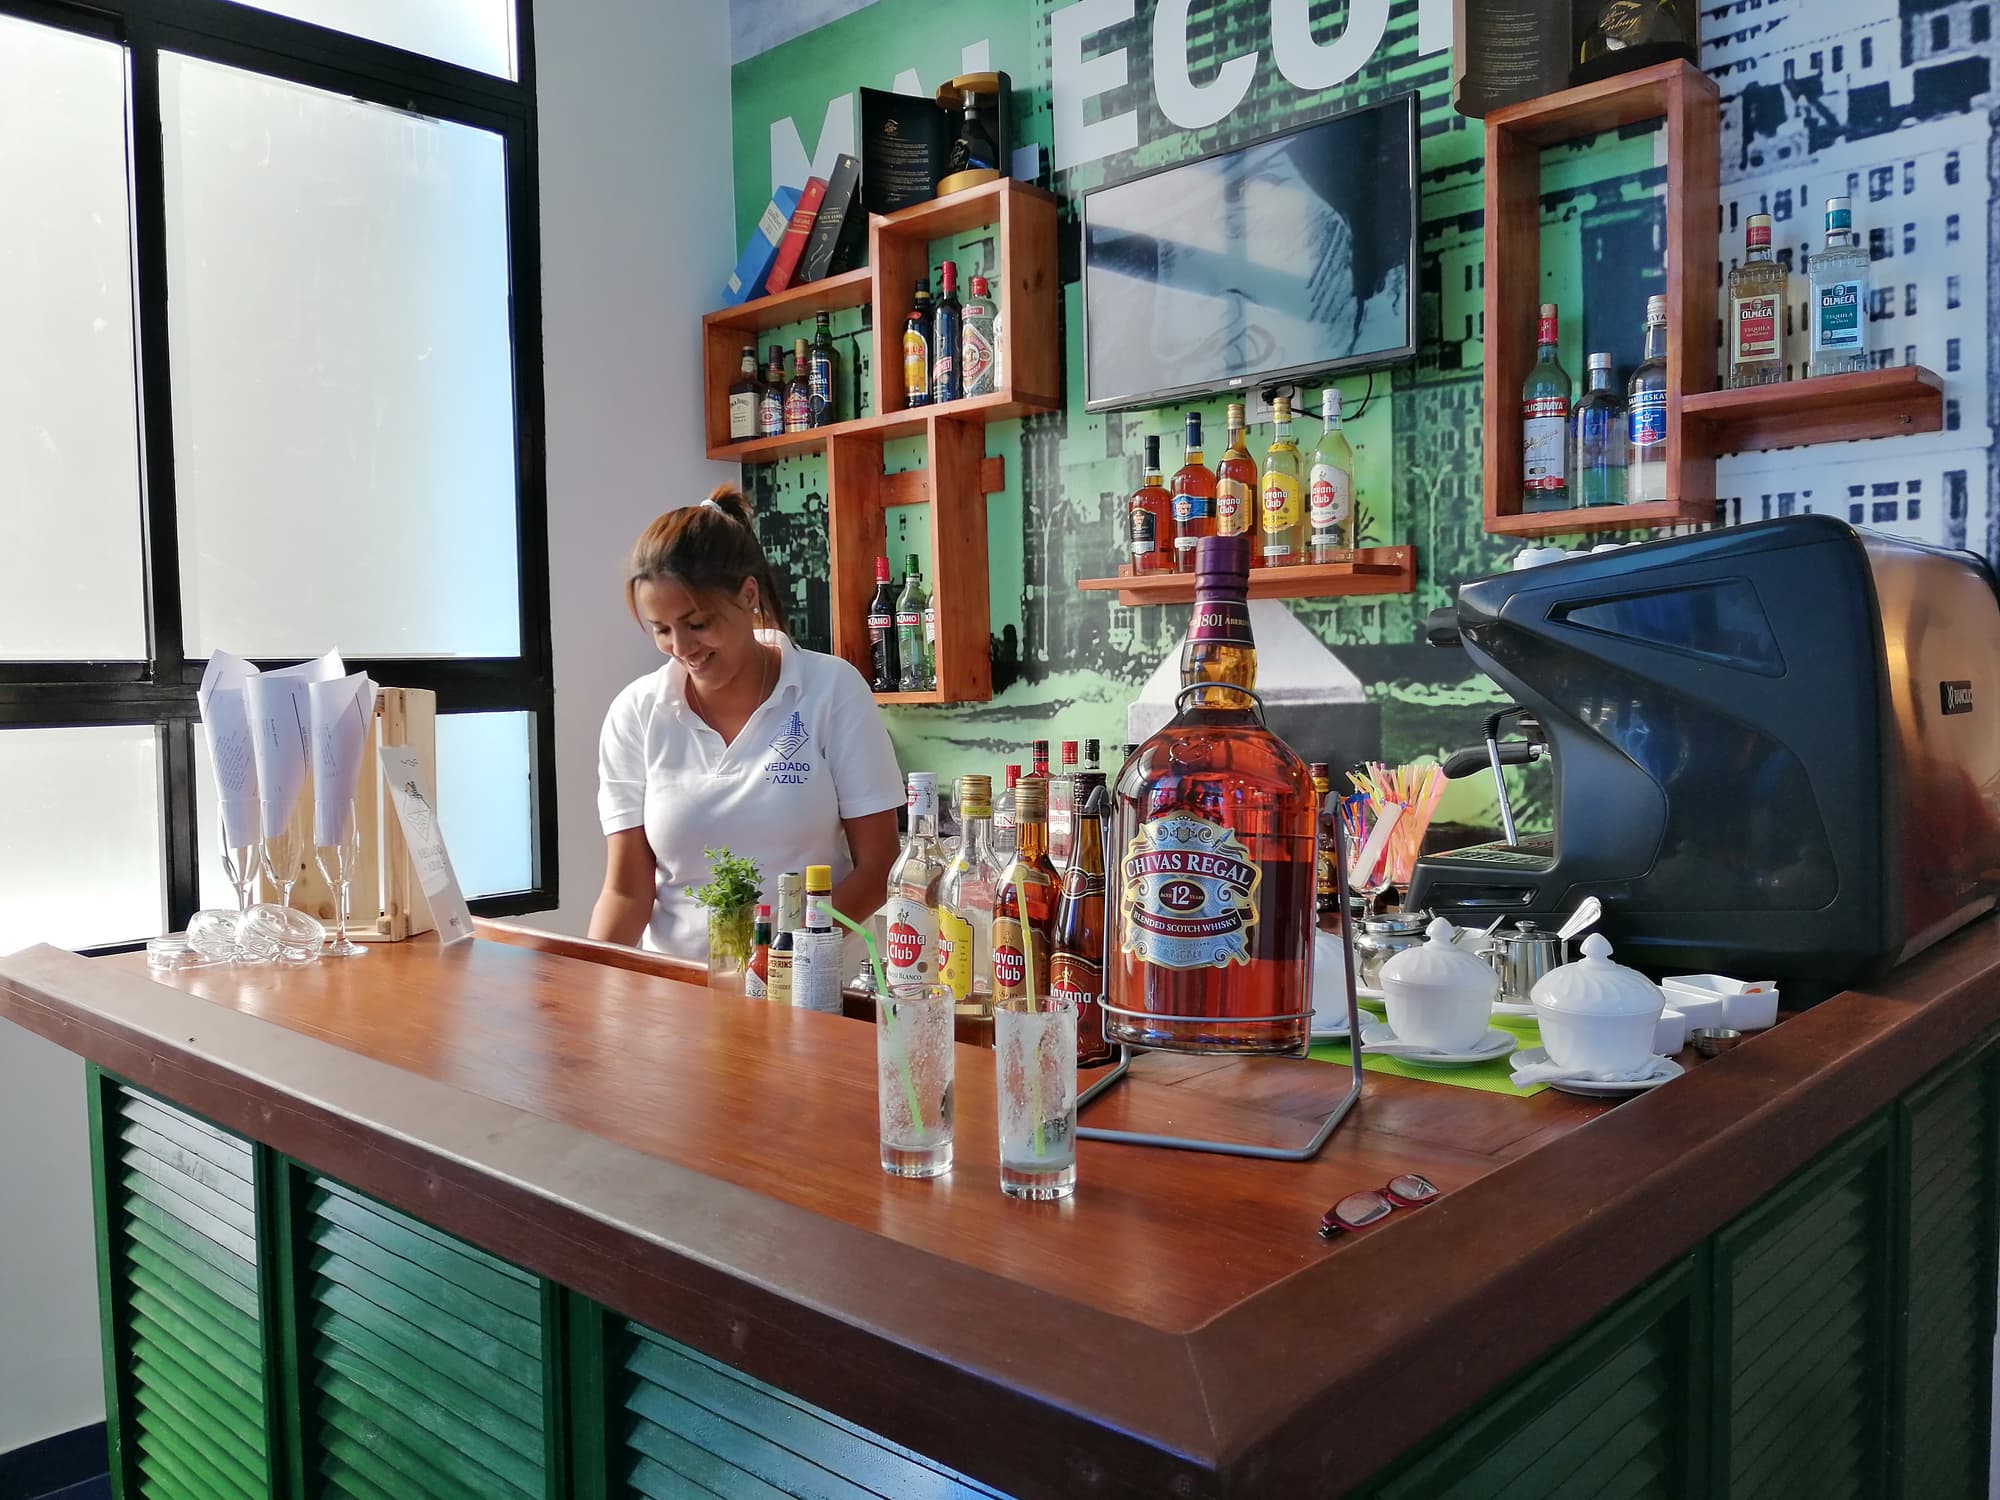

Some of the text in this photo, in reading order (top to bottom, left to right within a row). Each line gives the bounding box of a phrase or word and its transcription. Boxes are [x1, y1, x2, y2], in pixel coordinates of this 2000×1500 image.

[1823, 294, 1856, 306] OLMECA
[1741, 308, 1773, 319] OLMECA
[1219, 505, 1235, 514] Club
[1265, 499, 1281, 508] Club
[1197, 613, 1223, 627] 1801
[764, 762, 810, 772] VEDADO
[1126, 853, 1250, 886] CHIVAS REGAL
[1170, 885, 1191, 905] 12
[1133, 910, 1237, 933] BLENDED SCOTCH WHISKY
[889, 944, 913, 960] Club
[996, 964, 1021, 981] Club
